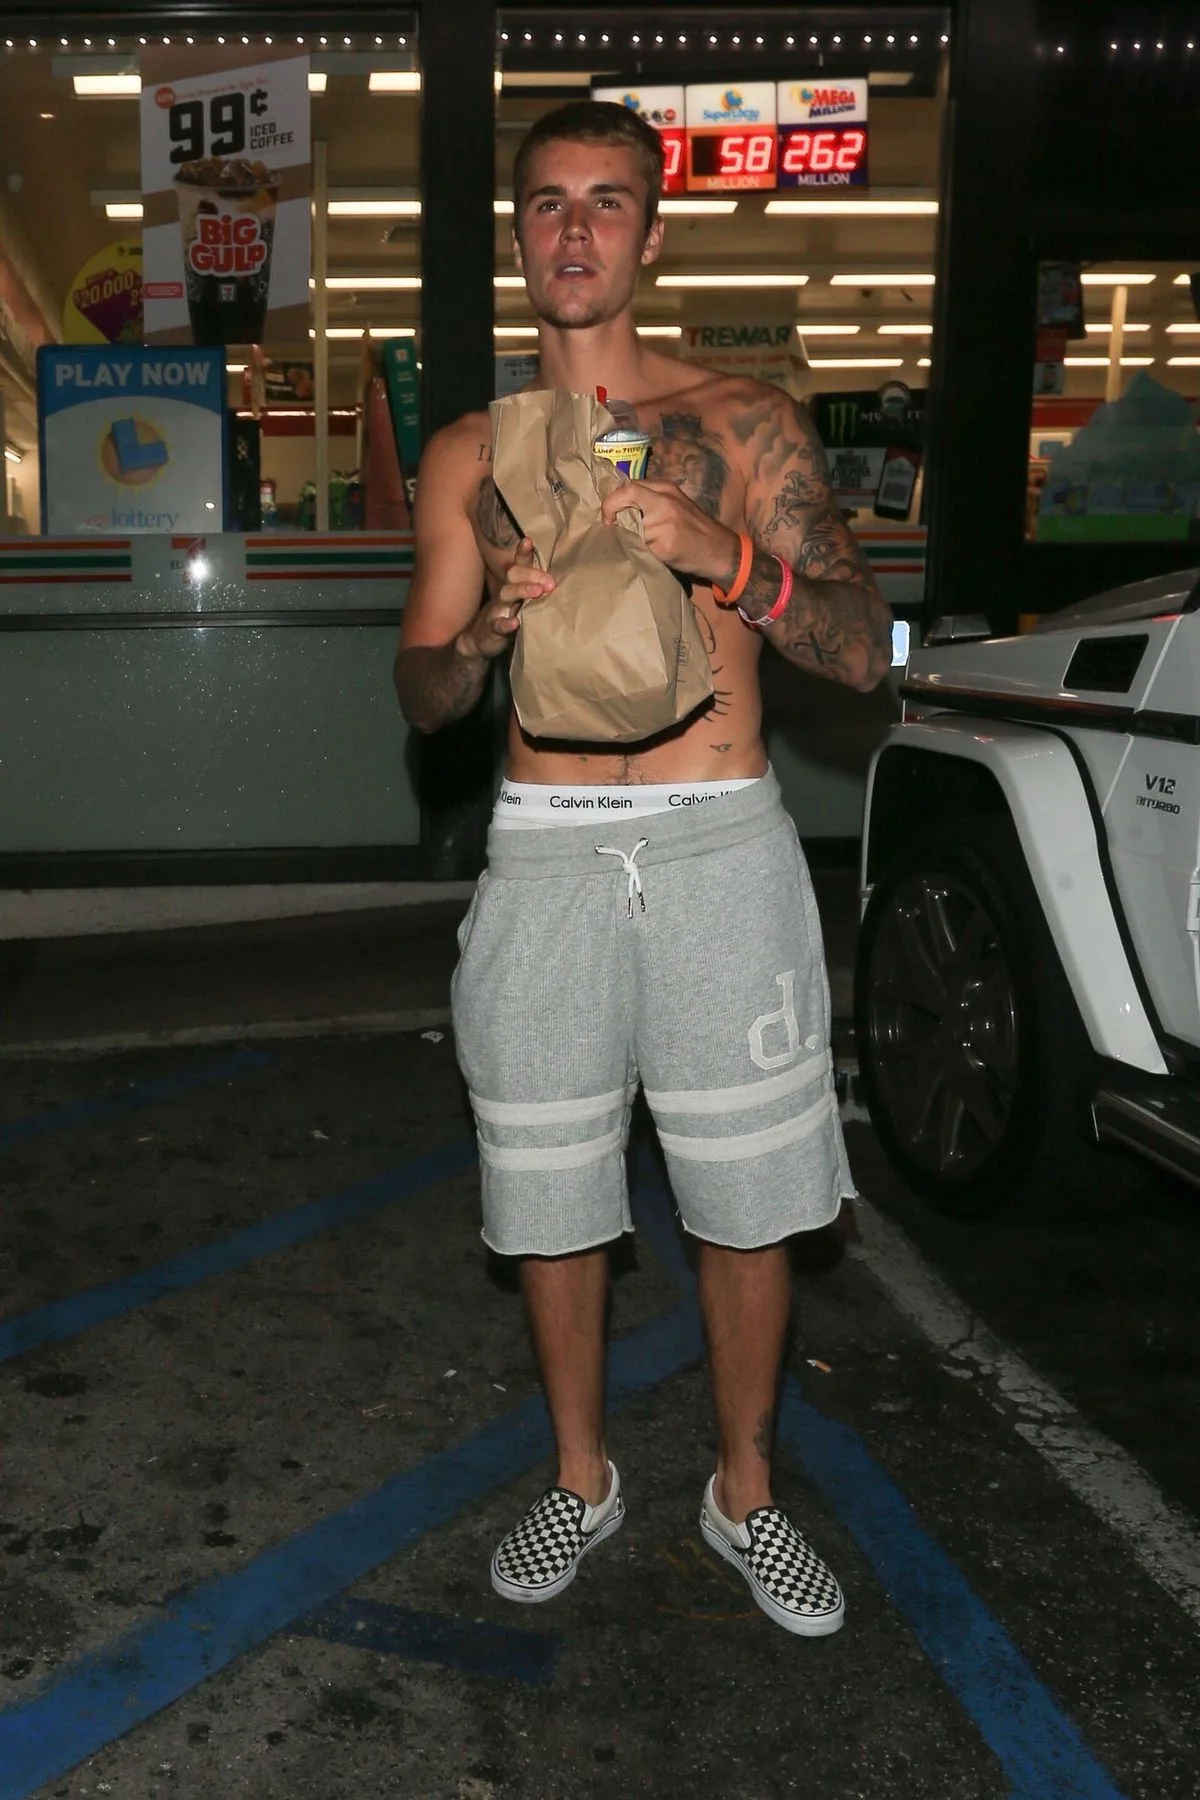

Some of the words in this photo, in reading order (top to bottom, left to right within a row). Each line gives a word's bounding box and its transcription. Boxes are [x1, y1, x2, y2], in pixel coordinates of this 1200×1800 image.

[812, 87, 857, 107] MEGA
[250, 122, 277, 137] ICED
[250, 132, 295, 150] COFFEE
[720, 135, 774, 173] 58
[783, 132, 865, 172] 262
[706, 176, 761, 190] MILLION
[798, 172, 851, 187] MILLION
[191, 244, 265, 273] GULP
[55, 363, 132, 388] PLAY
[141, 361, 211, 387] NOW
[1146, 774, 1176, 794] V12
[549, 795, 594, 809] Calvin
[597, 795, 633, 809] Klein
[1136, 795, 1181, 815] BITURBO
